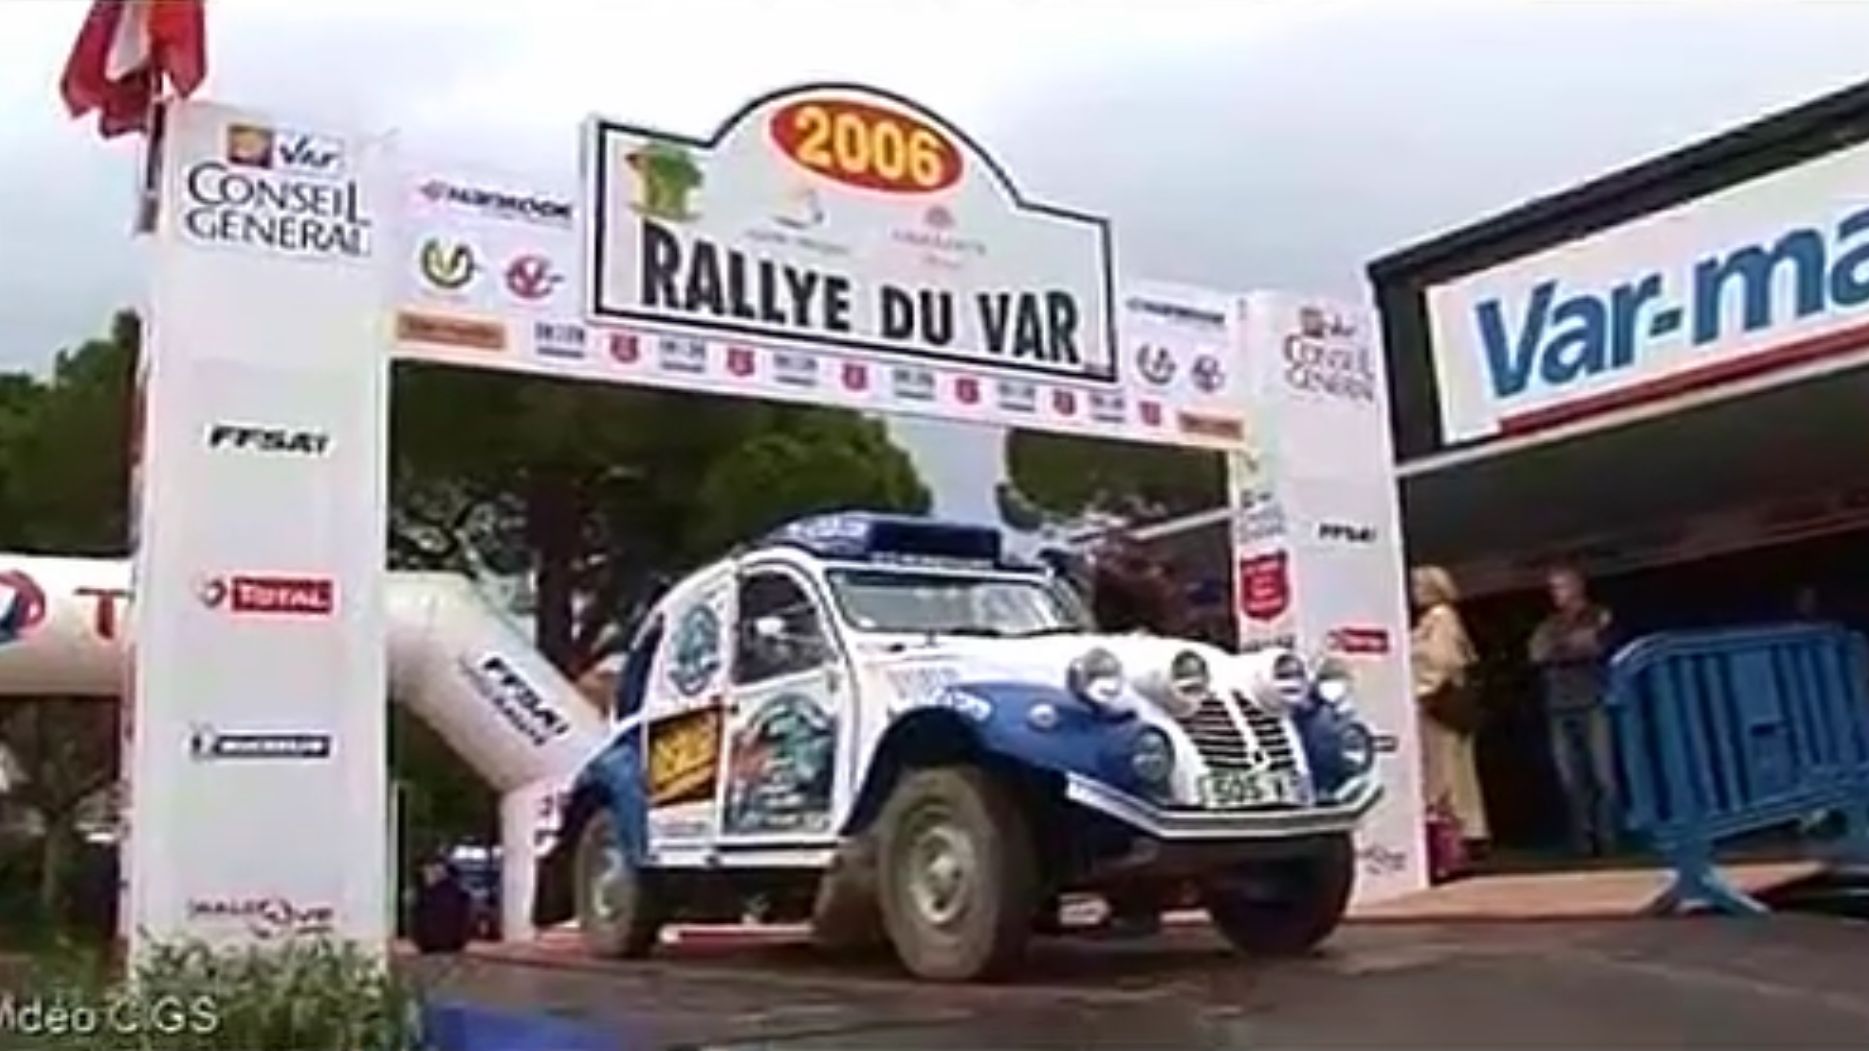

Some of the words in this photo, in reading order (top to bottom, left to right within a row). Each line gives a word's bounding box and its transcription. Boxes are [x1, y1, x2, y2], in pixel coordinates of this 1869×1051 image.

[279, 135, 341, 168] Var
[793, 105, 946, 188] 2006
[641, 219, 852, 333] RALLYE
[880, 285, 953, 346] DU
[977, 290, 1080, 365] VAR
